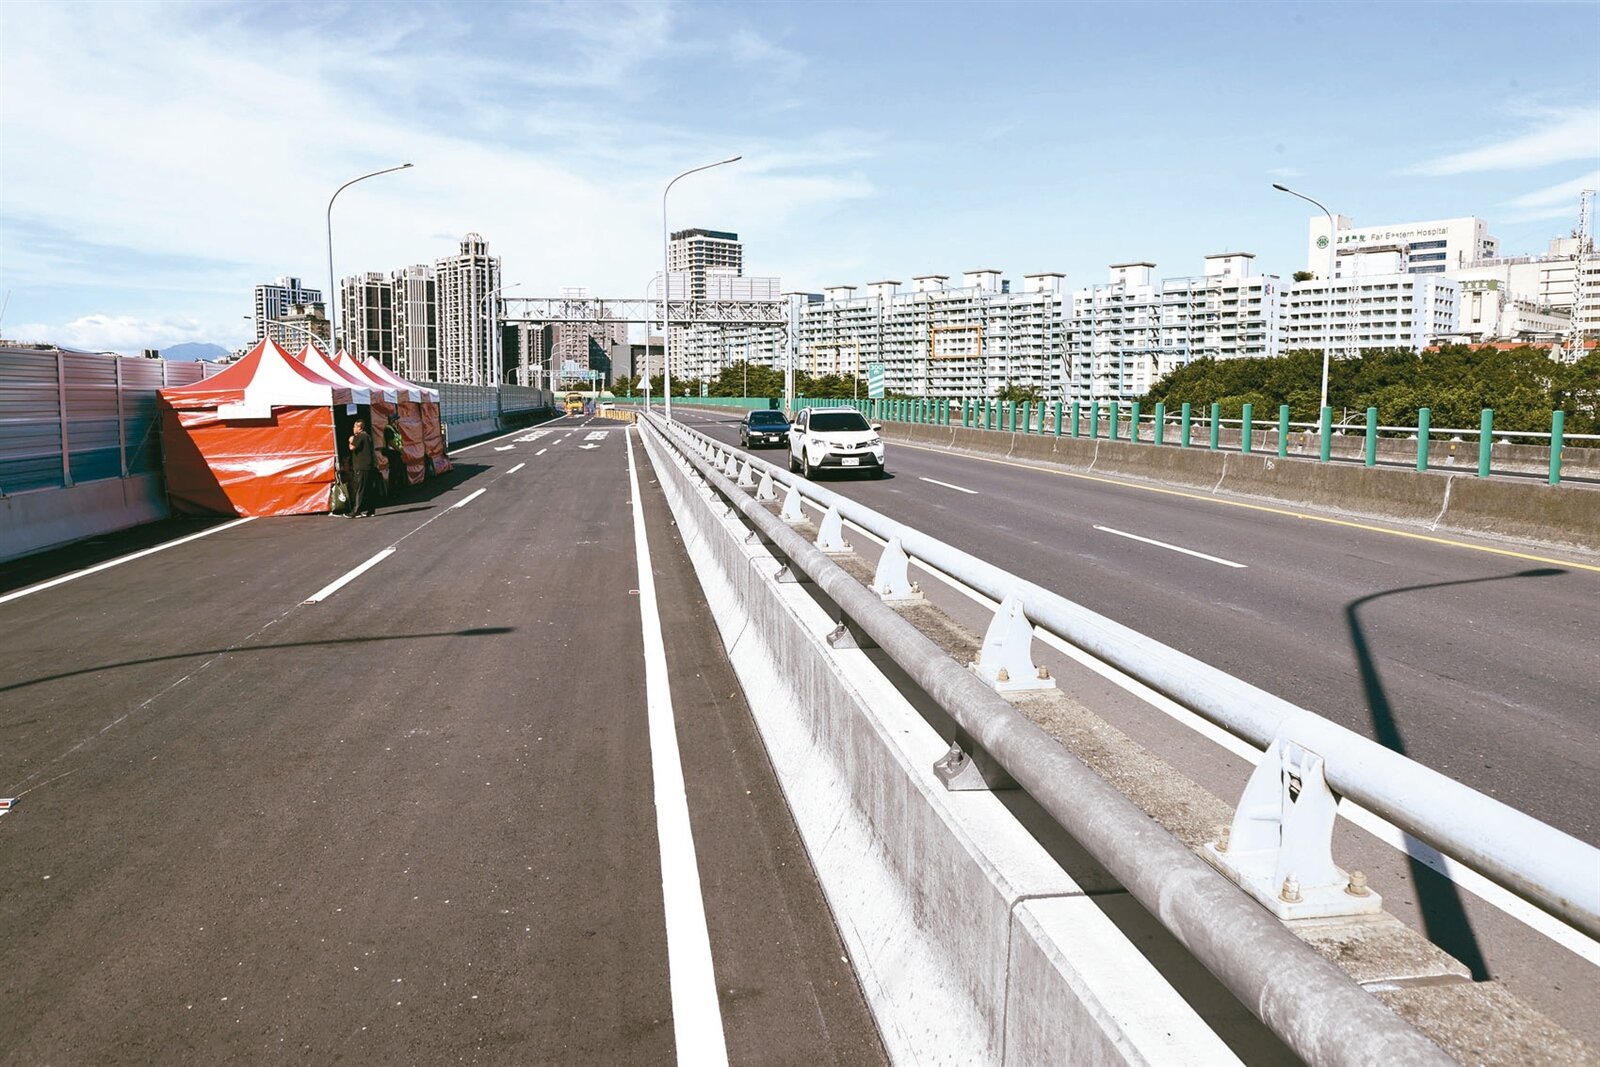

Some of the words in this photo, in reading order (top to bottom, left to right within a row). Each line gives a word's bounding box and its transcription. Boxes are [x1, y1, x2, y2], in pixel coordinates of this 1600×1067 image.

[1371, 232, 1384, 241] Far
[1385, 230, 1415, 240] Eastern
[1417, 226, 1449, 237] Hospital
